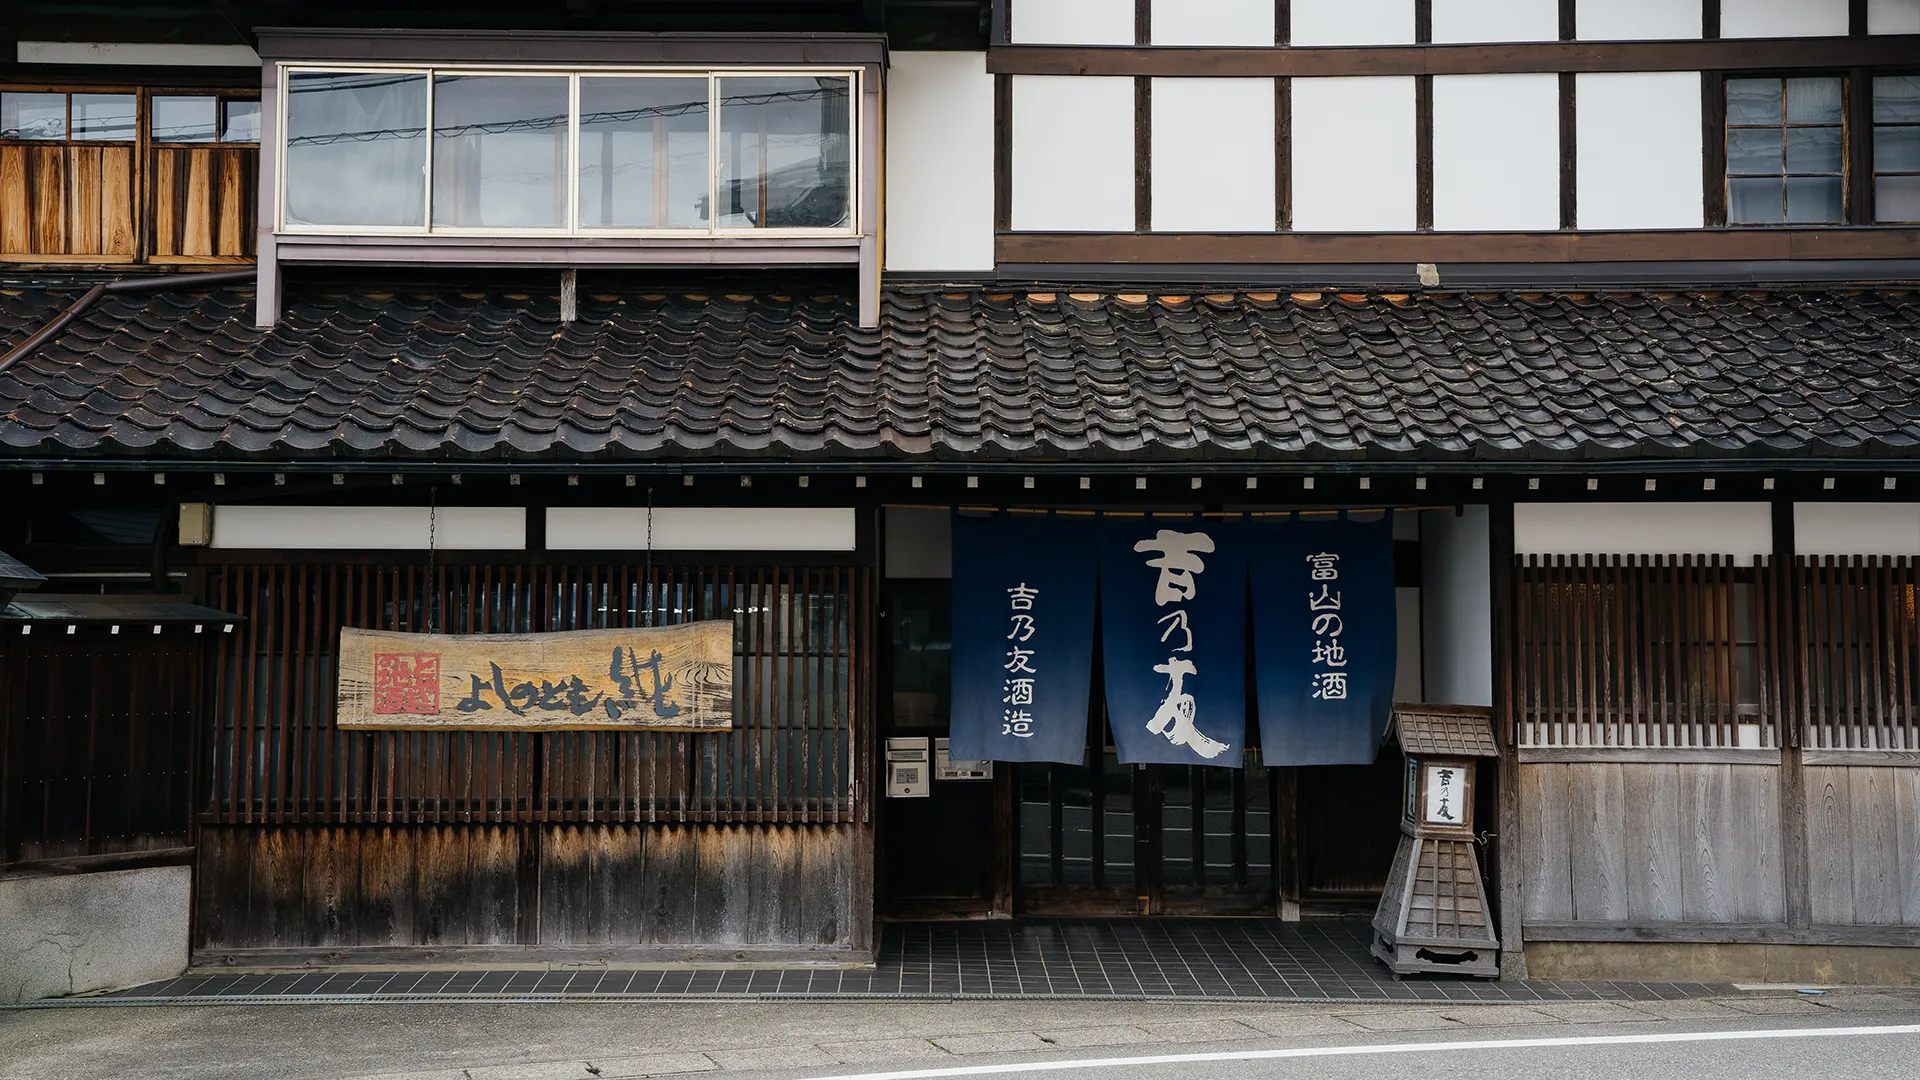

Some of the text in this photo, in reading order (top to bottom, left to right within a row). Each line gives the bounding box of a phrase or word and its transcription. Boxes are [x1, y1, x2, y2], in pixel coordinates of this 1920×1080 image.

[1001, 582, 1039, 738] 吉乃友酒造
[1306, 551, 1348, 700] 富山の地酒
